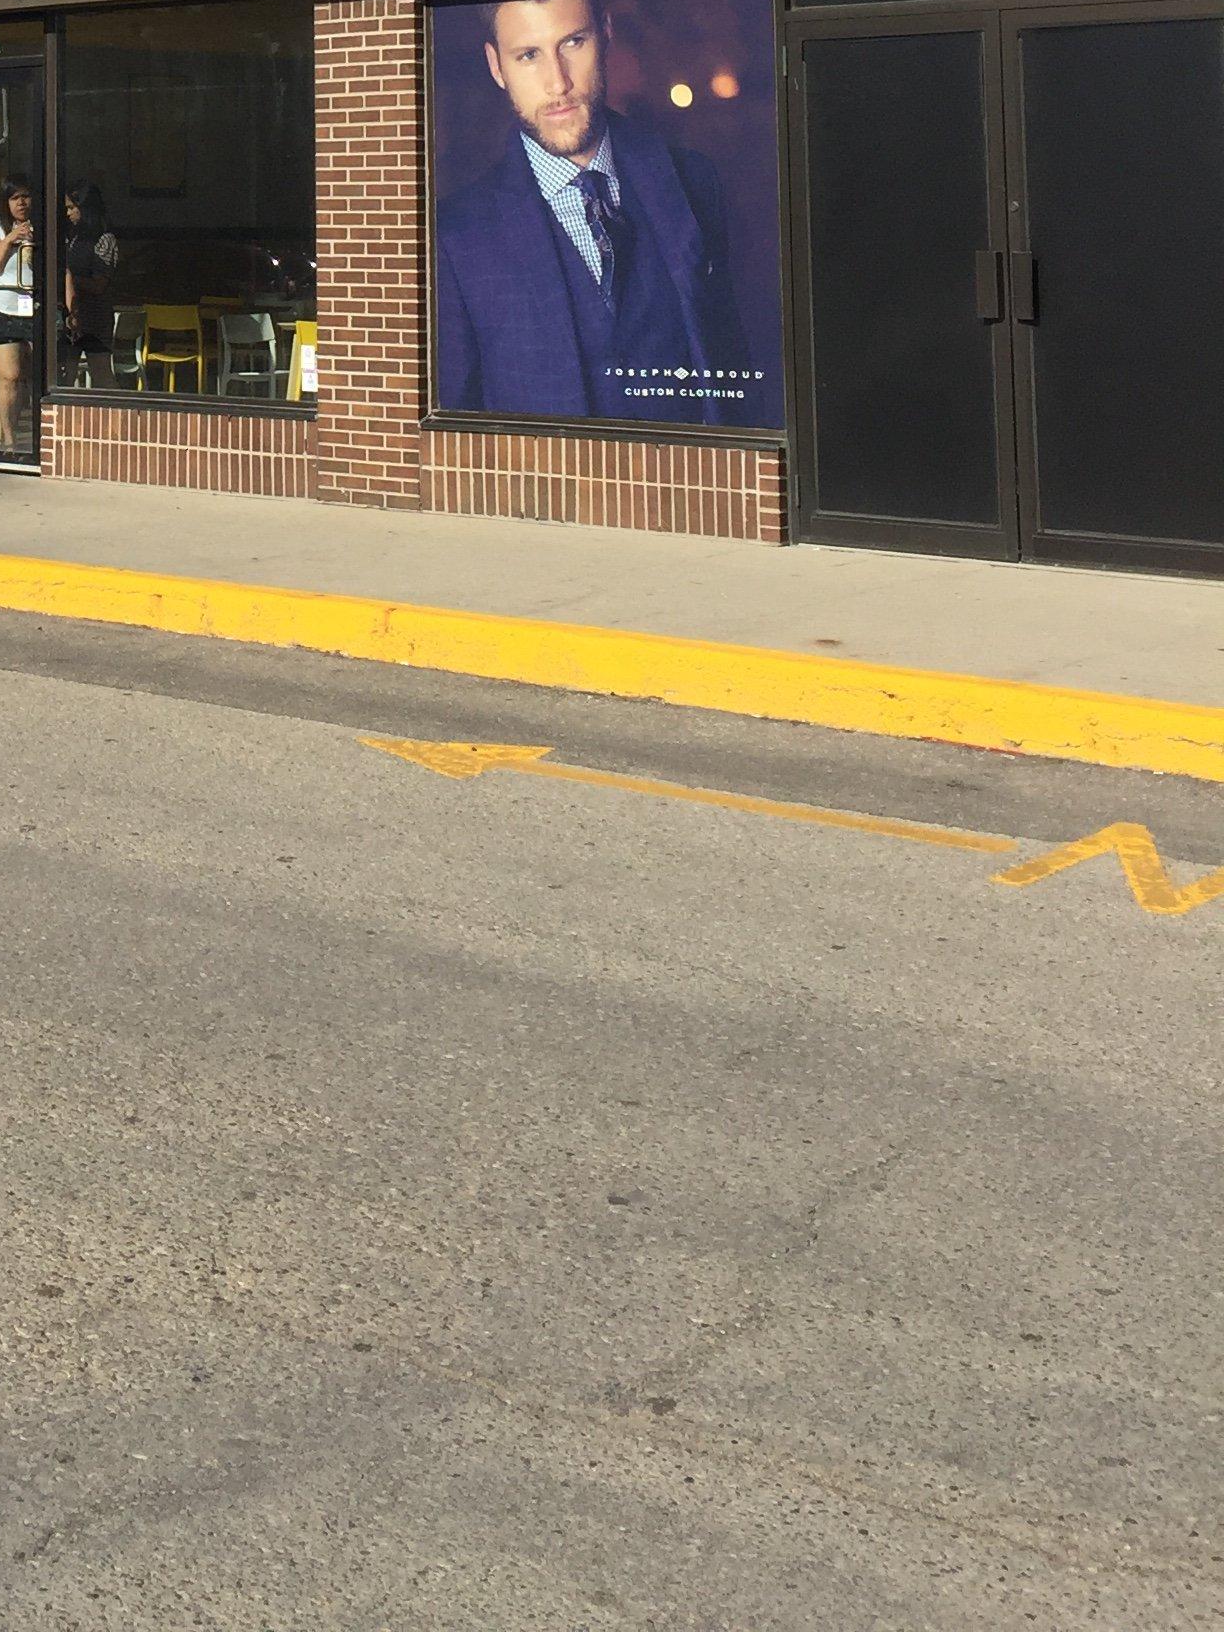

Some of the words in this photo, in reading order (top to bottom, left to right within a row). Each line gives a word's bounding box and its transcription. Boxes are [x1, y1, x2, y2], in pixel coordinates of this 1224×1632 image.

[604, 368, 672, 377] JOSEPH
[690, 369, 764, 379] ABBOUD
[625, 387, 674, 397] CUSTOM
[680, 388, 745, 399] CLOTHING
